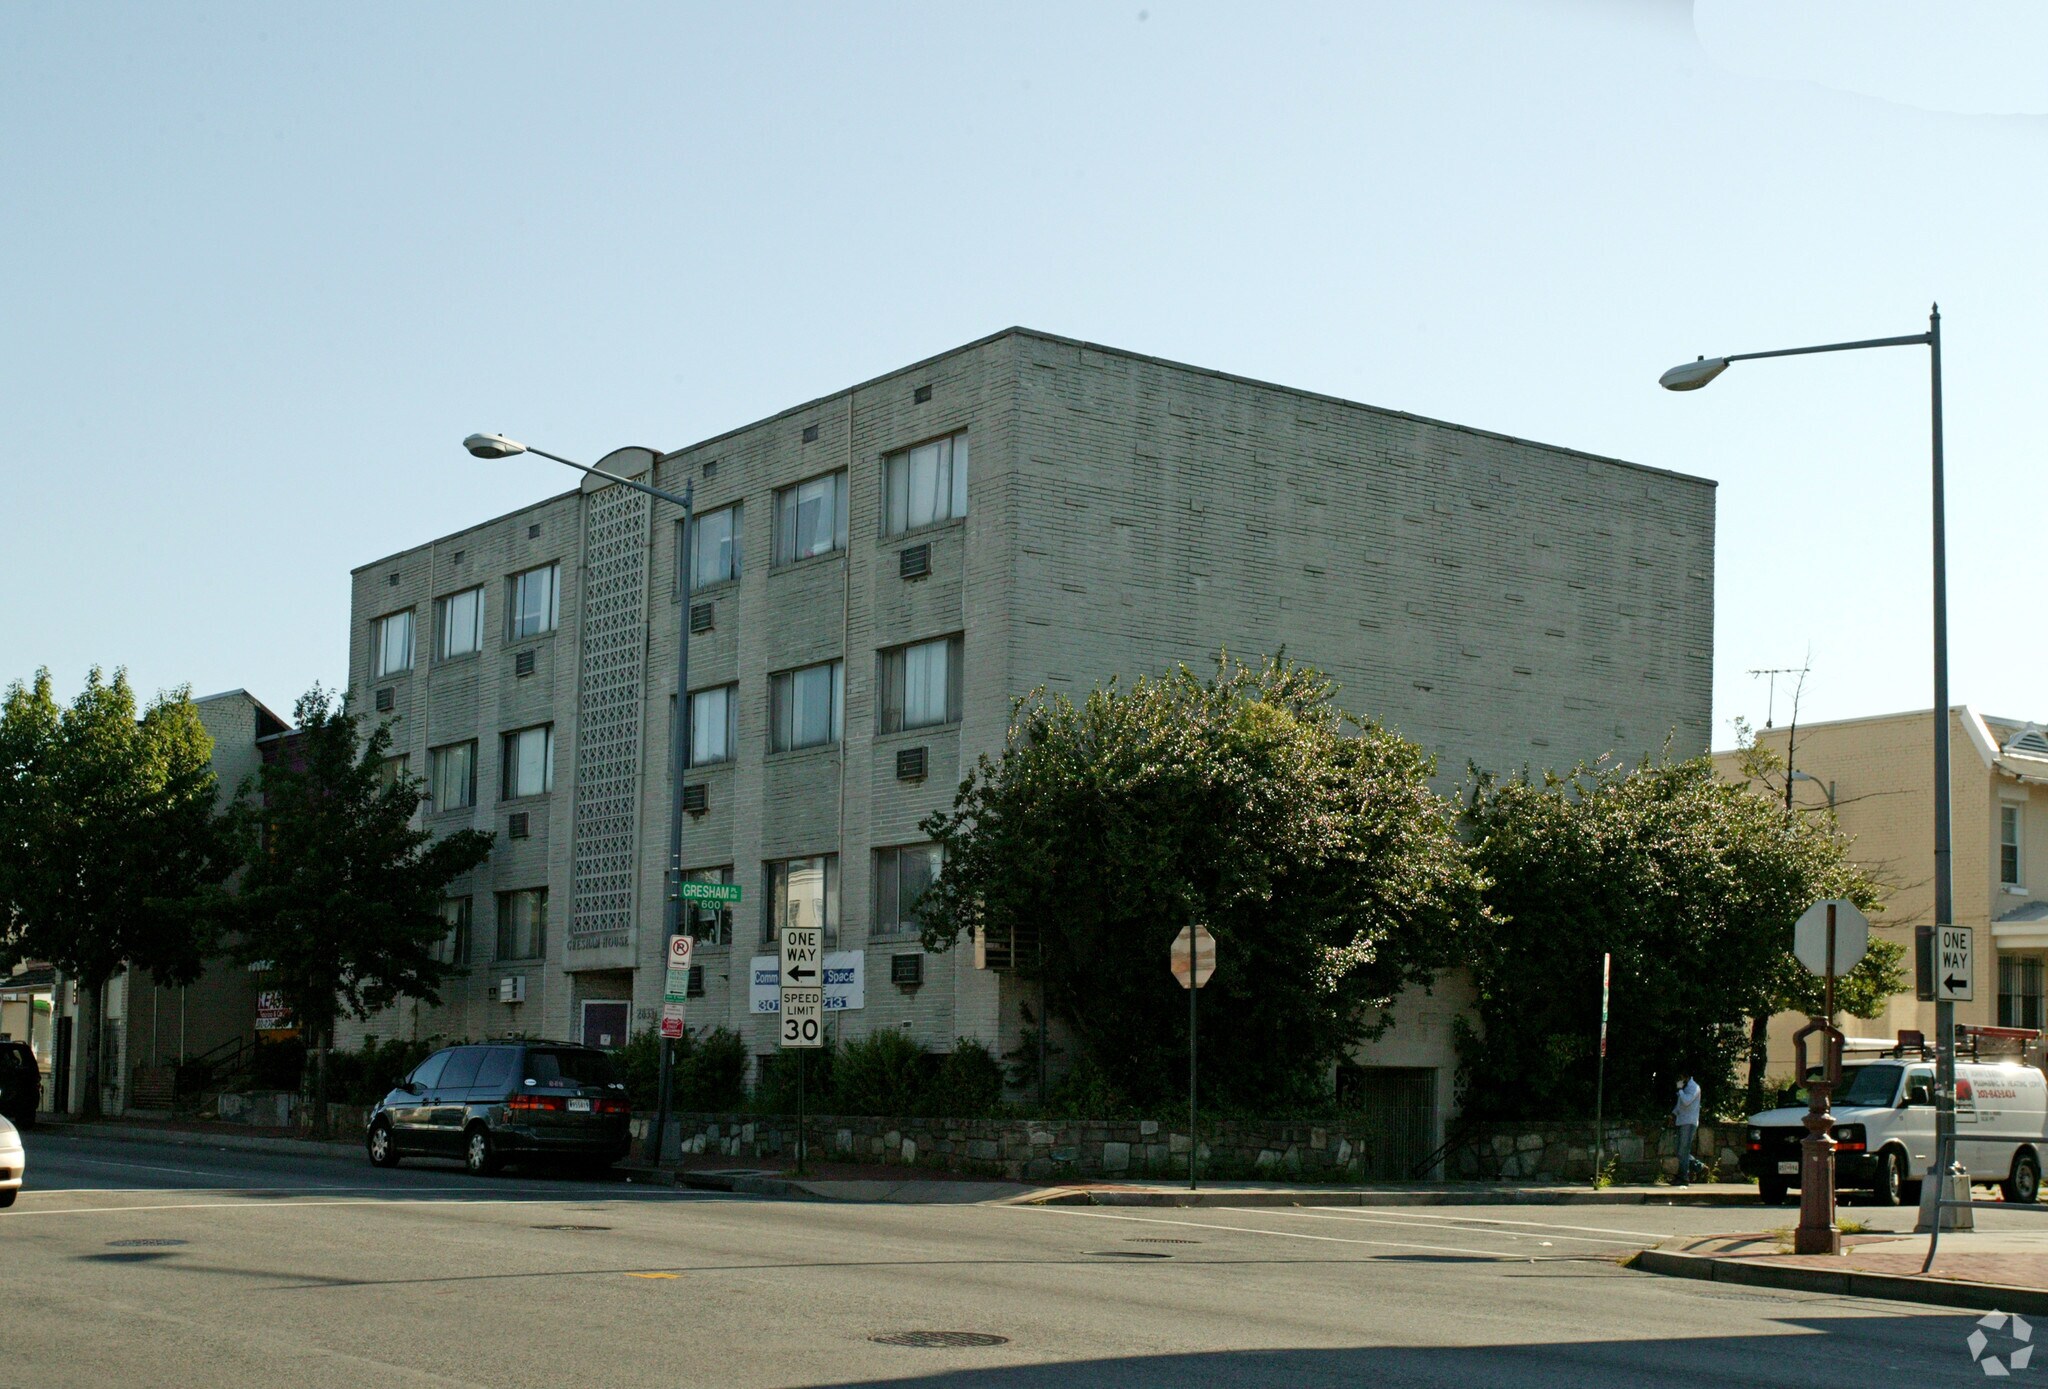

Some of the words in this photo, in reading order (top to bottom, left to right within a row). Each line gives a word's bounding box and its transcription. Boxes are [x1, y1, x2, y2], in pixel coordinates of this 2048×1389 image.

[683, 884, 729, 899] GRESHAM
[701, 900, 720, 909] 600
[602, 936, 629, 949] HOUSE
[788, 932, 815, 946] ONE
[1943, 932, 1967, 949] ONE
[787, 948, 816, 961] WAY
[1943, 952, 1967, 969] WAY
[828, 970, 855, 984] Space
[784, 994, 819, 1003] SPEED
[787, 1006, 815, 1015] LIMIT
[784, 1019, 818, 1040] 30
